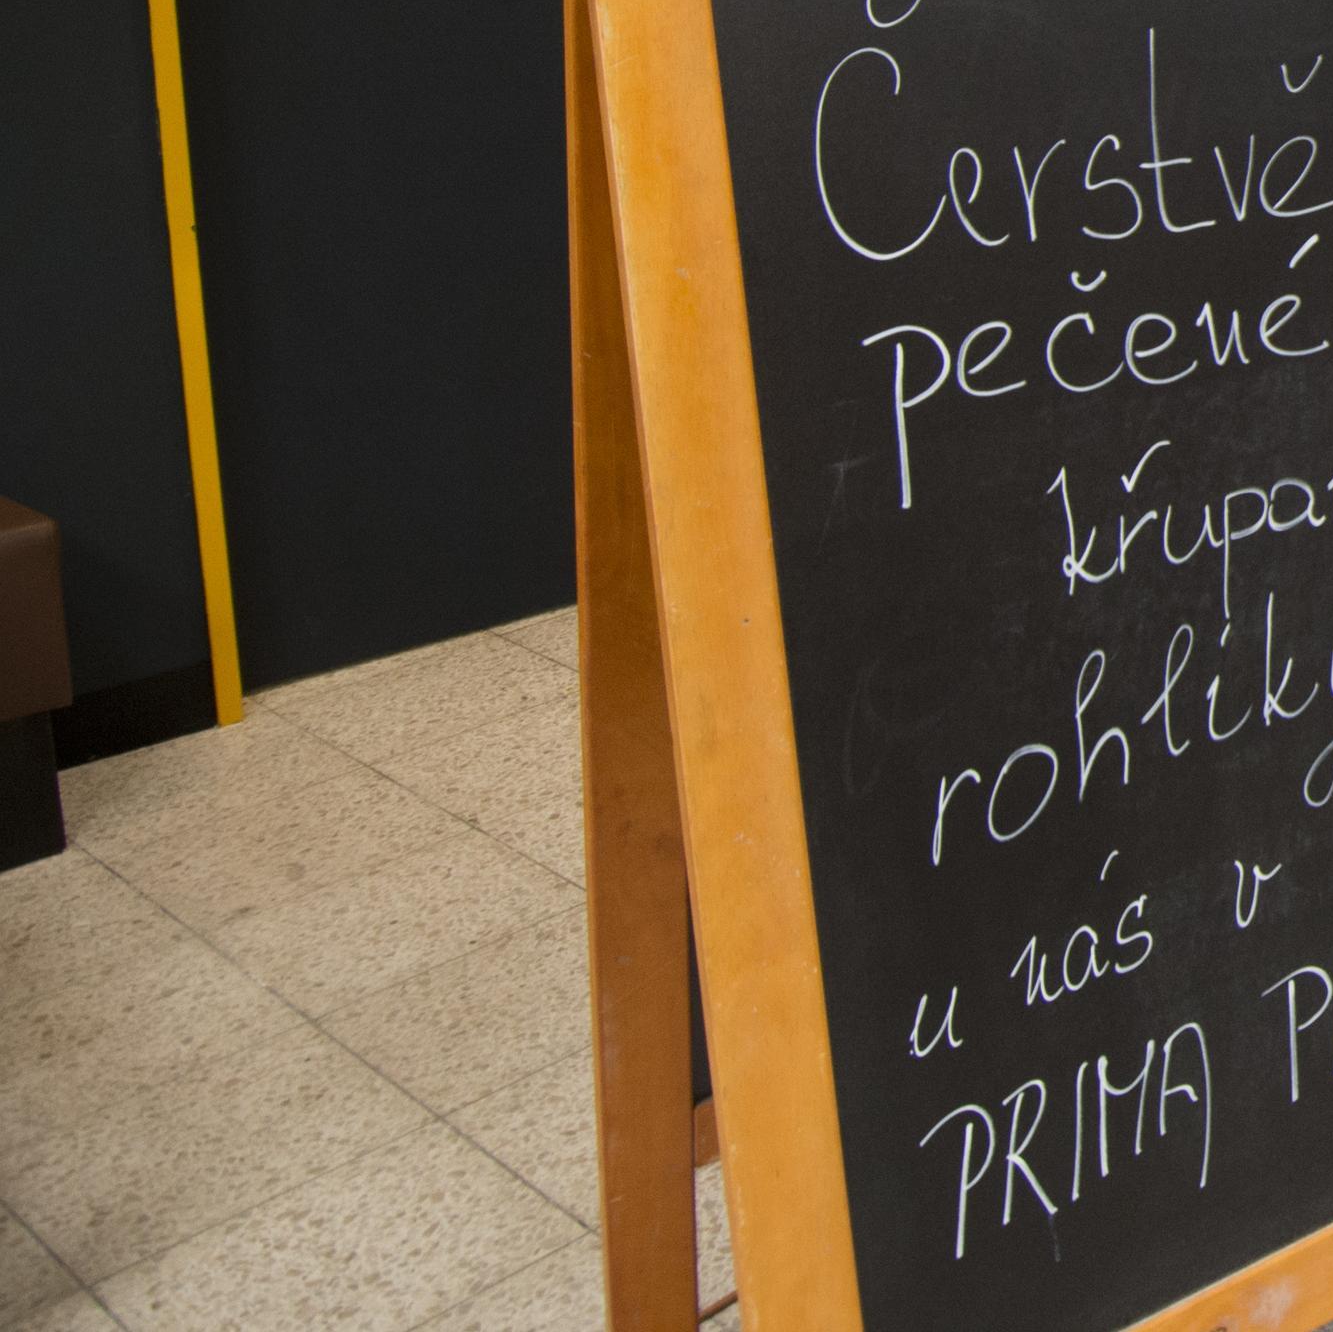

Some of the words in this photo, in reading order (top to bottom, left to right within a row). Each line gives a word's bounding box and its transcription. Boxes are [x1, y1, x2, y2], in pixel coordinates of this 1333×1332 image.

[862, 234, 1329, 509] pečené
[909, 986, 963, 1058] u
[1011, 849, 1154, 1005] nás
[1234, 859, 1283, 929] v
[918, 1021, 1213, 1260] PRIMA
